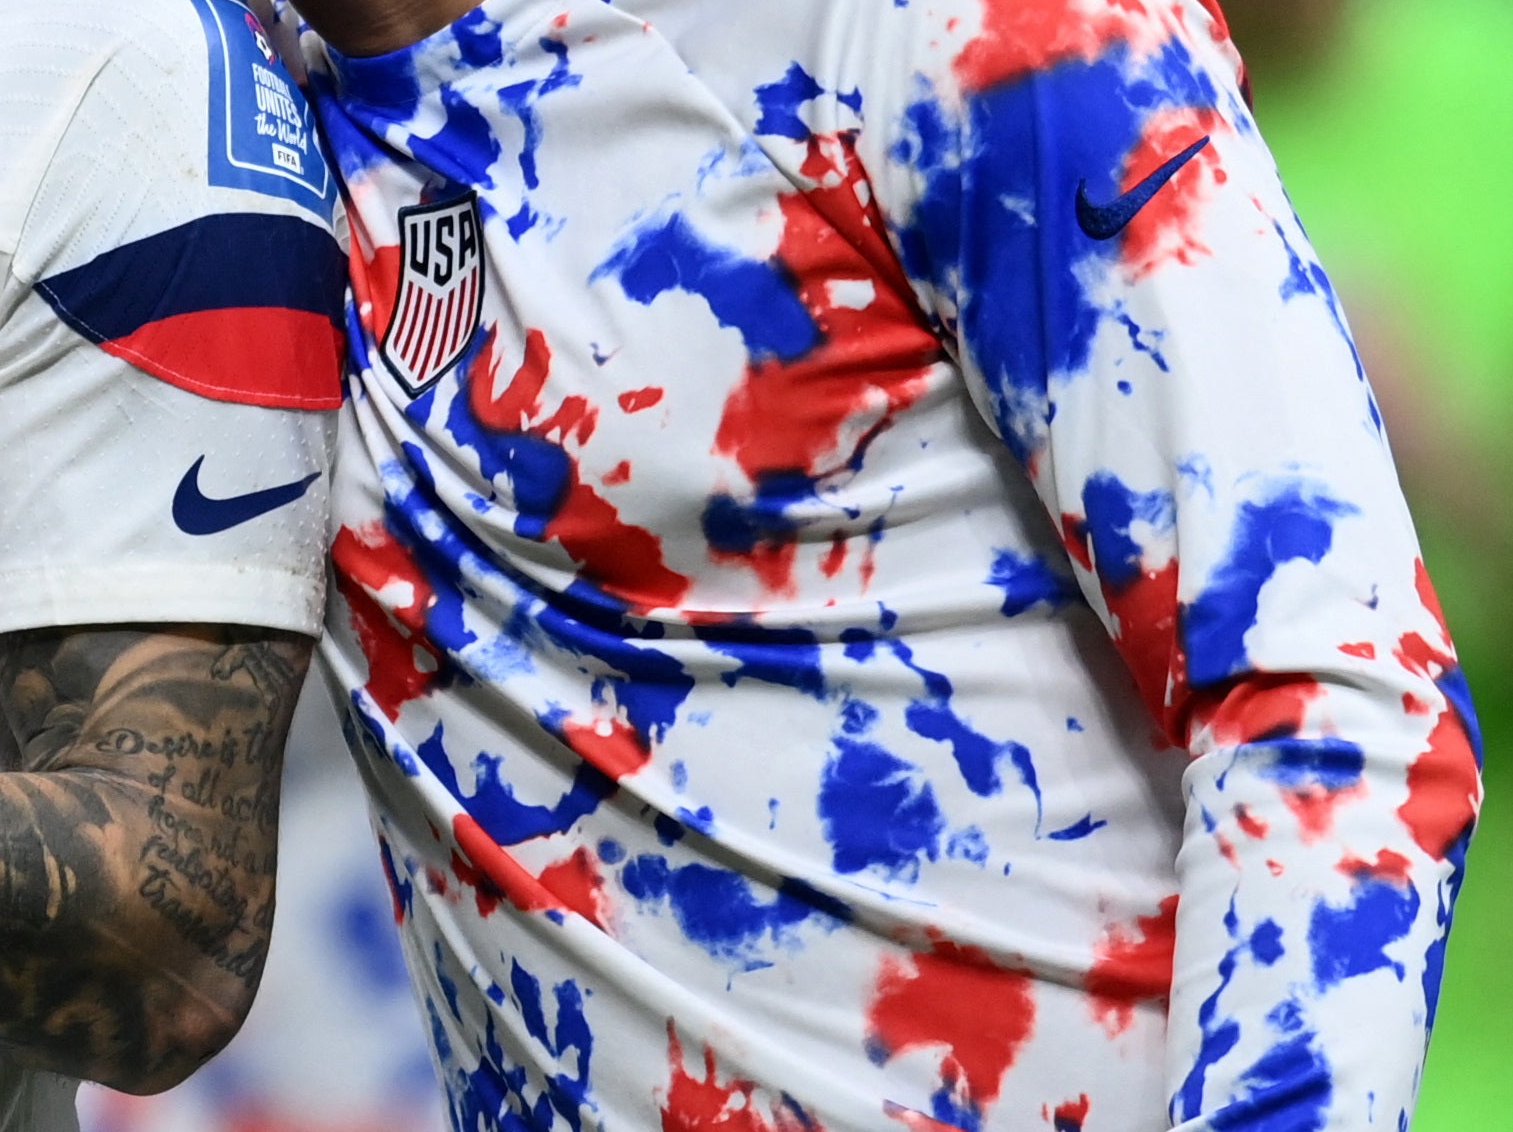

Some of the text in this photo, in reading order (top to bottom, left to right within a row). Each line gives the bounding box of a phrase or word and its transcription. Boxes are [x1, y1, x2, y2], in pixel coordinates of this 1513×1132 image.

[255, 83, 303, 129] UNITES
[253, 112, 308, 156] the World
[277, 150, 297, 168] FIFA
[410, 209, 477, 287] USA
